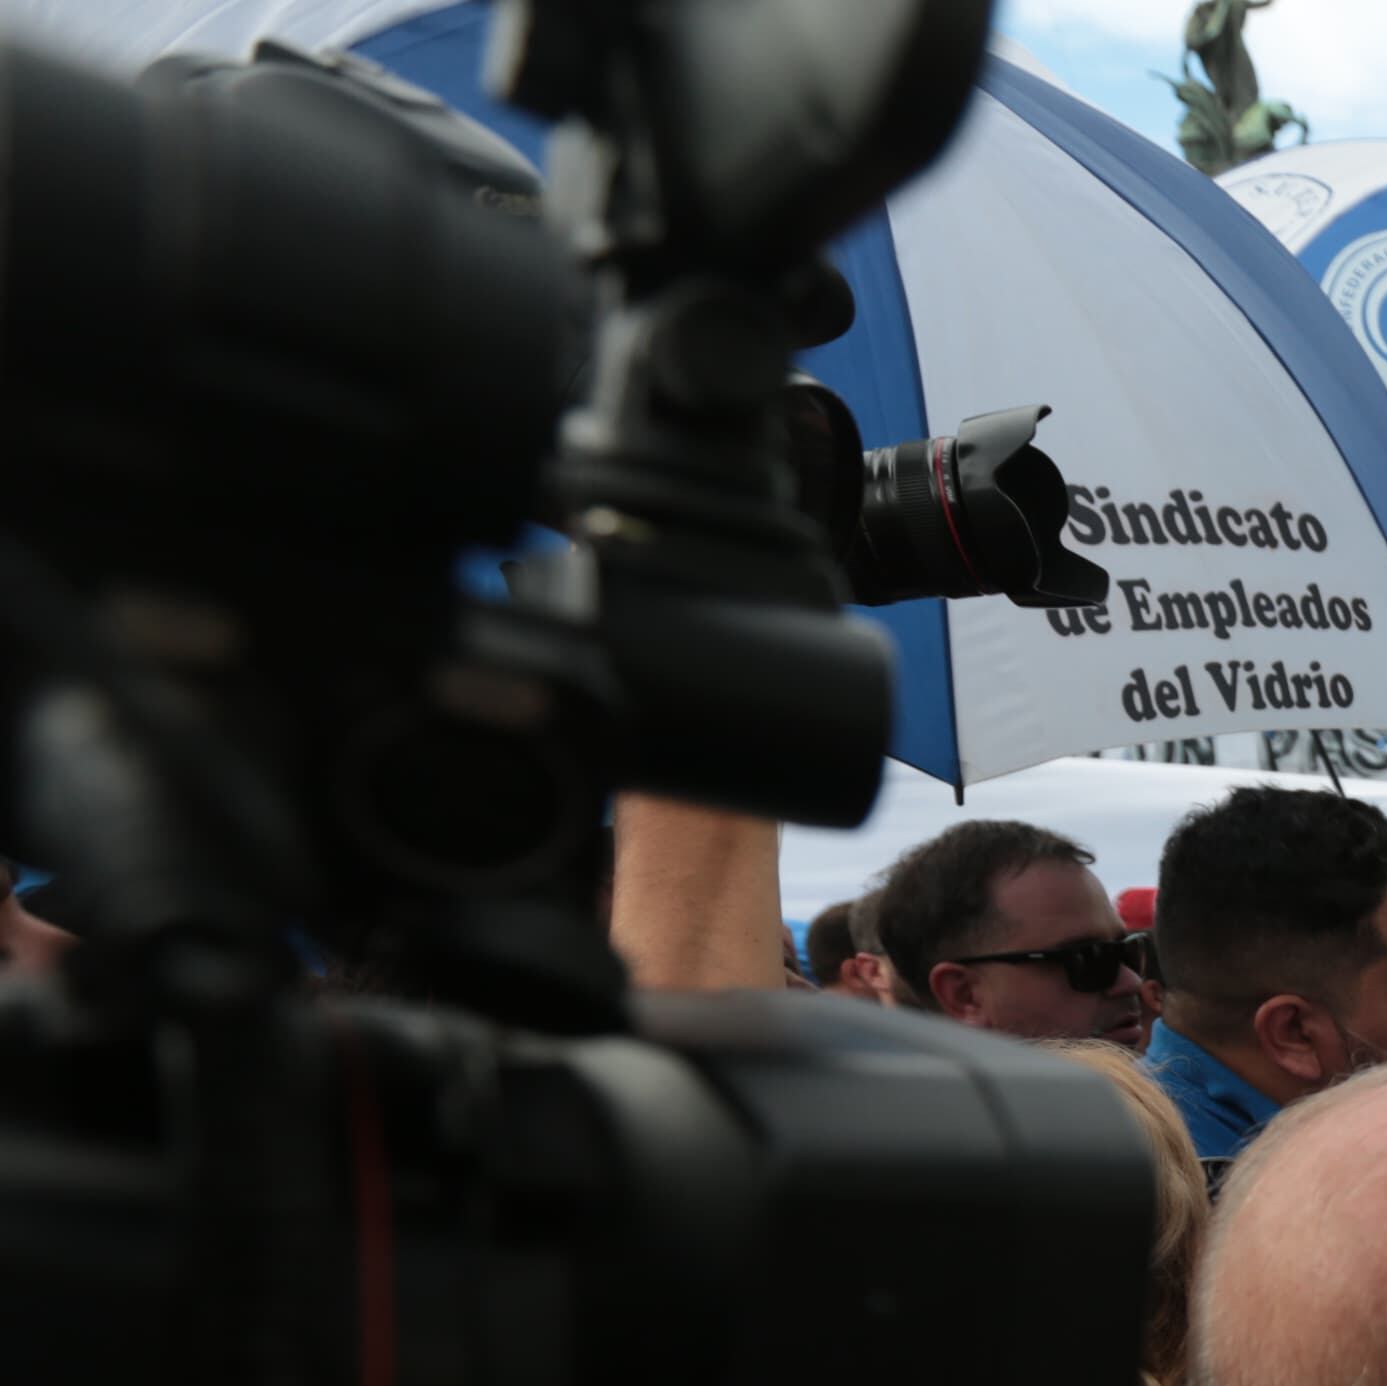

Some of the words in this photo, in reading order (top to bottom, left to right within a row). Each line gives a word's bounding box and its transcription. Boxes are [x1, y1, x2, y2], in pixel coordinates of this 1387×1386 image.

[1066, 484, 1328, 552] Sindicato
[1116, 578, 1373, 640] Empleados
[1121, 664, 1201, 723] del
[1204, 660, 1354, 713] Vidrio
